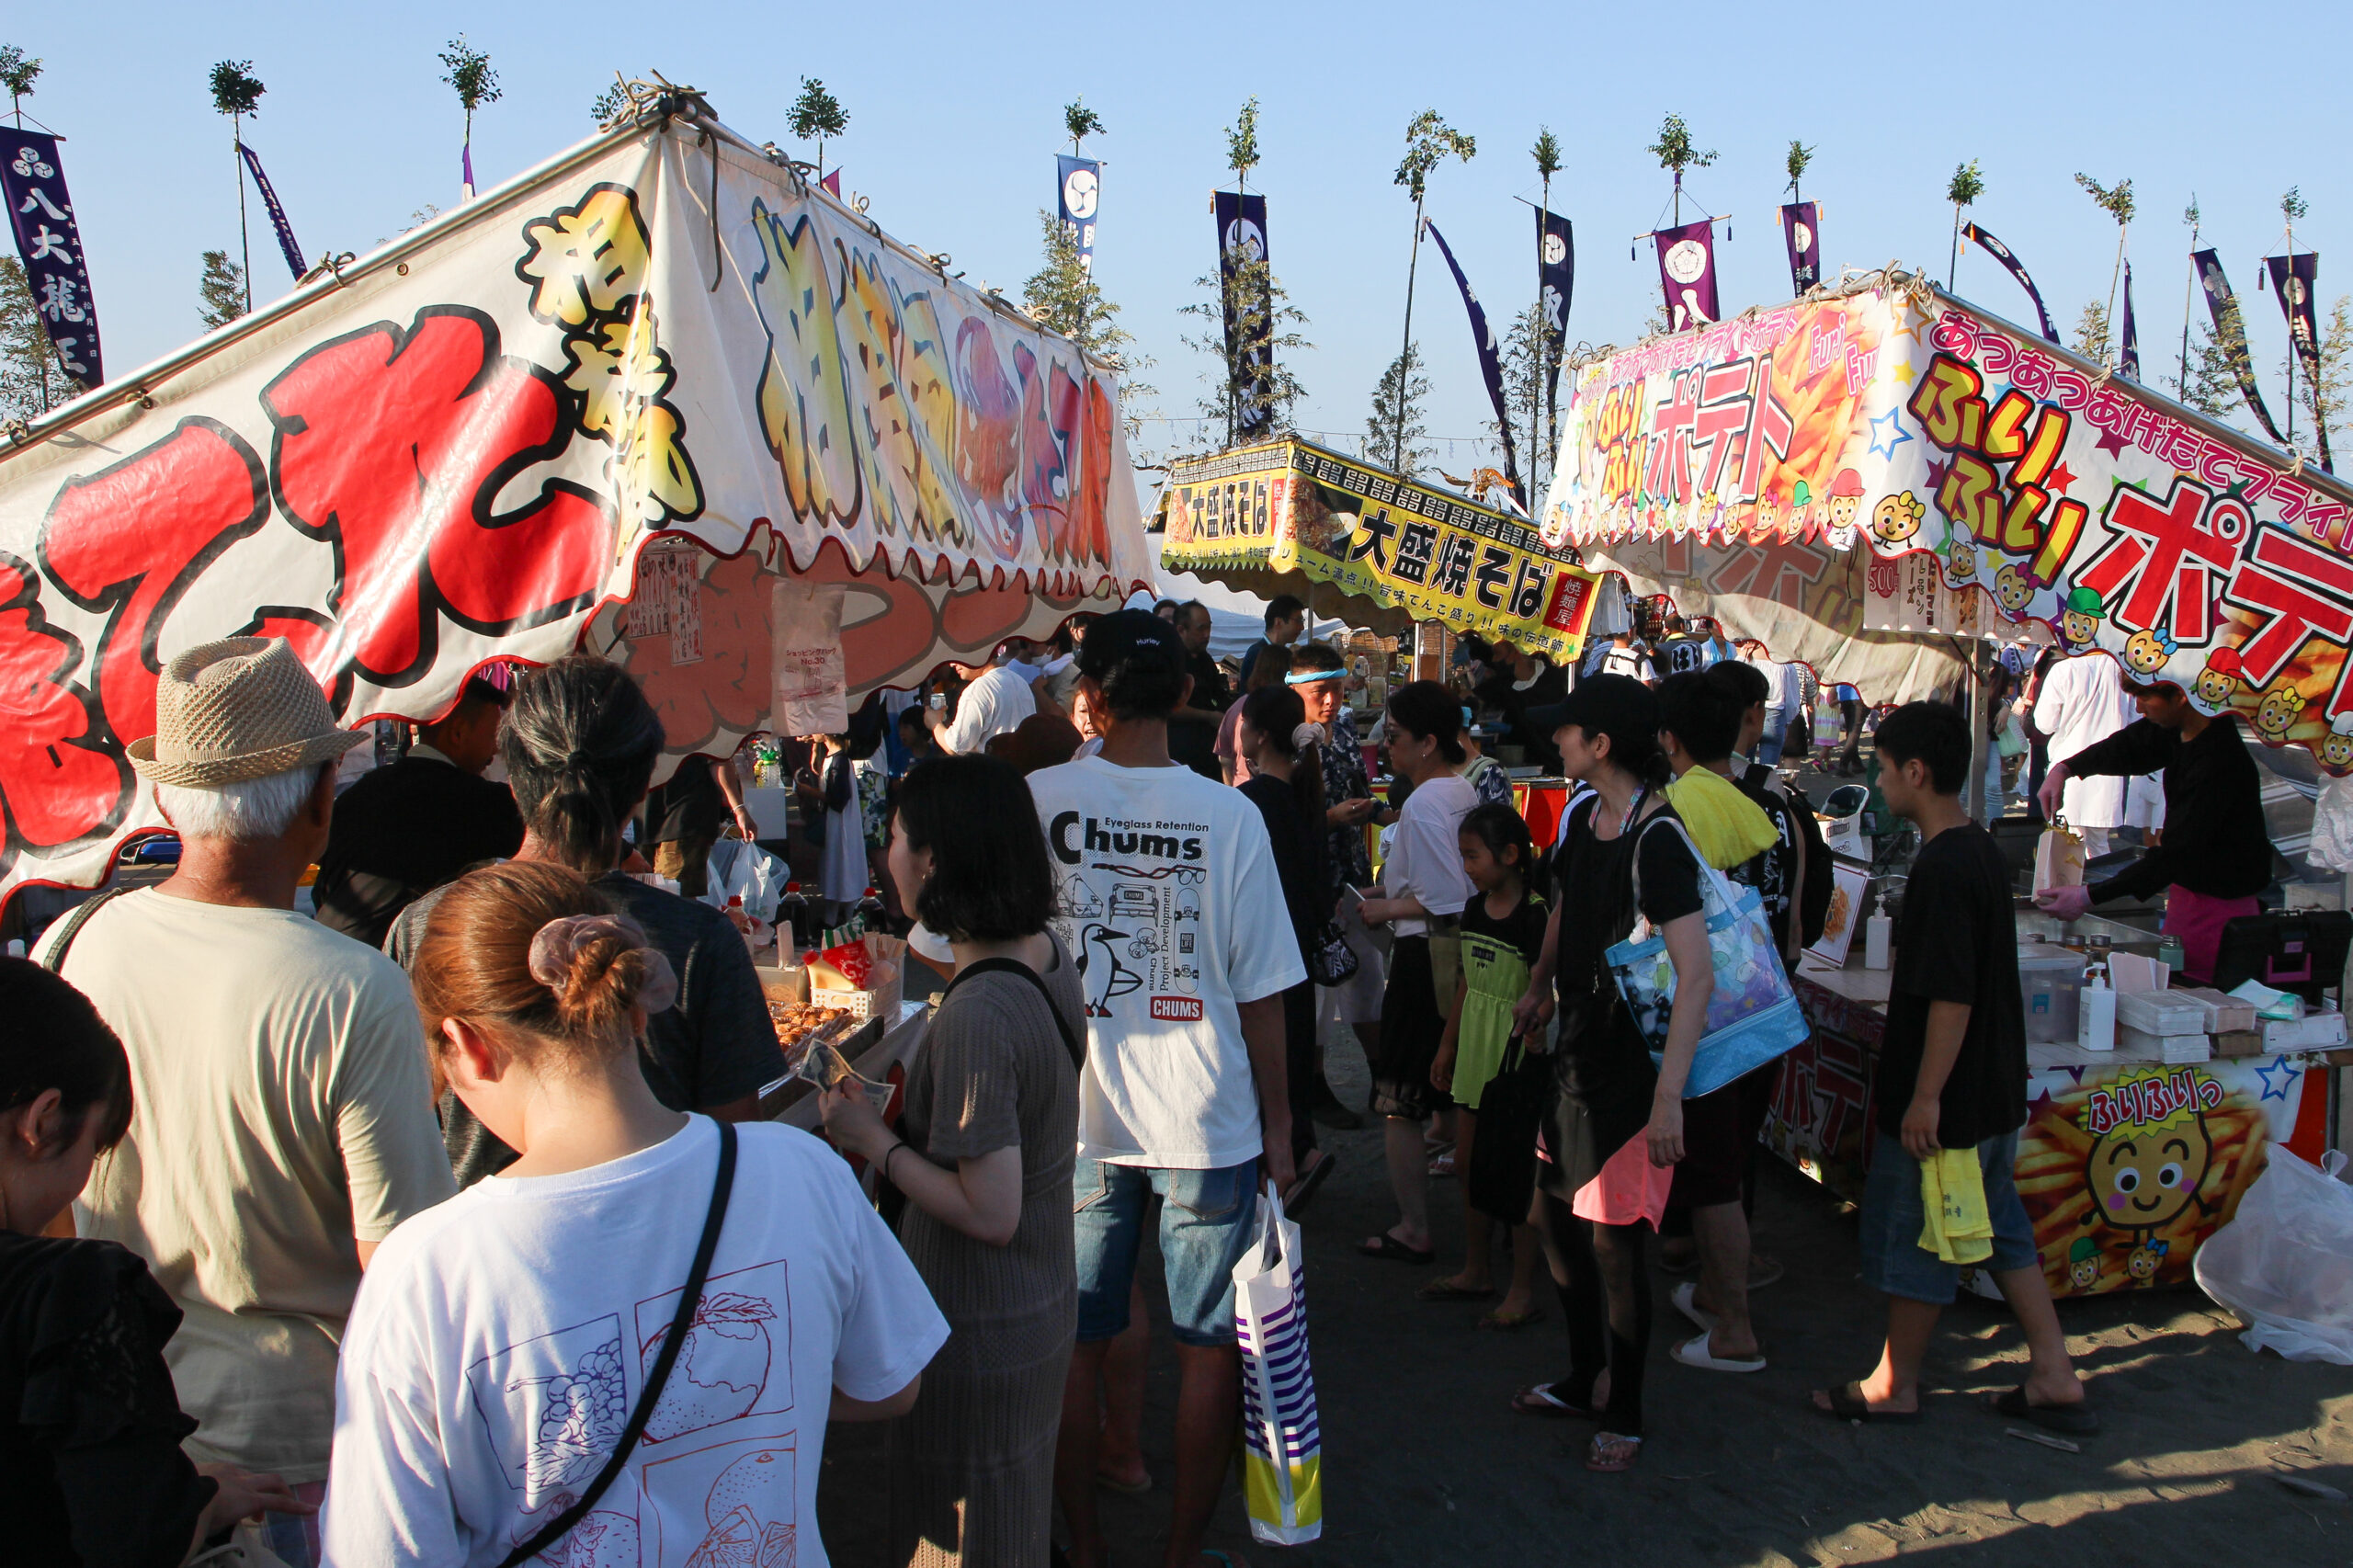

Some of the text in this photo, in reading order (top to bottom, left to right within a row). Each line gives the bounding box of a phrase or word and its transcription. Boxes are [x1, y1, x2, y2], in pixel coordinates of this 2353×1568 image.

[1809, 311, 1847, 376] Furi
[1597, 378, 1645, 453] ふり
[1644, 353, 1794, 505] ポテト
[1910, 352, 2071, 489] ふり
[1600, 431, 1648, 507] ふり
[1192, 472, 1270, 540] 大盛焼そば
[1935, 454, 2091, 591] ふり
[1347, 506, 1555, 620] 大盛焼そば
[1916, 557, 1928, 616] レモン
[2068, 475, 2353, 722] ポテ
[801, 656, 825, 665] No.30
[1136, 638, 1161, 646] Hurley
[1050, 811, 1203, 865] Chums
[1105, 817, 1210, 833] Eyeglass Retention
[1124, 891, 1144, 900] CHUMS
[1160, 887, 1171, 992] Project Development
[1149, 958, 1157, 992] Chums
[1153, 999, 1200, 1018] CHUMS
[2088, 1069, 2224, 1134] ふりふりっ
